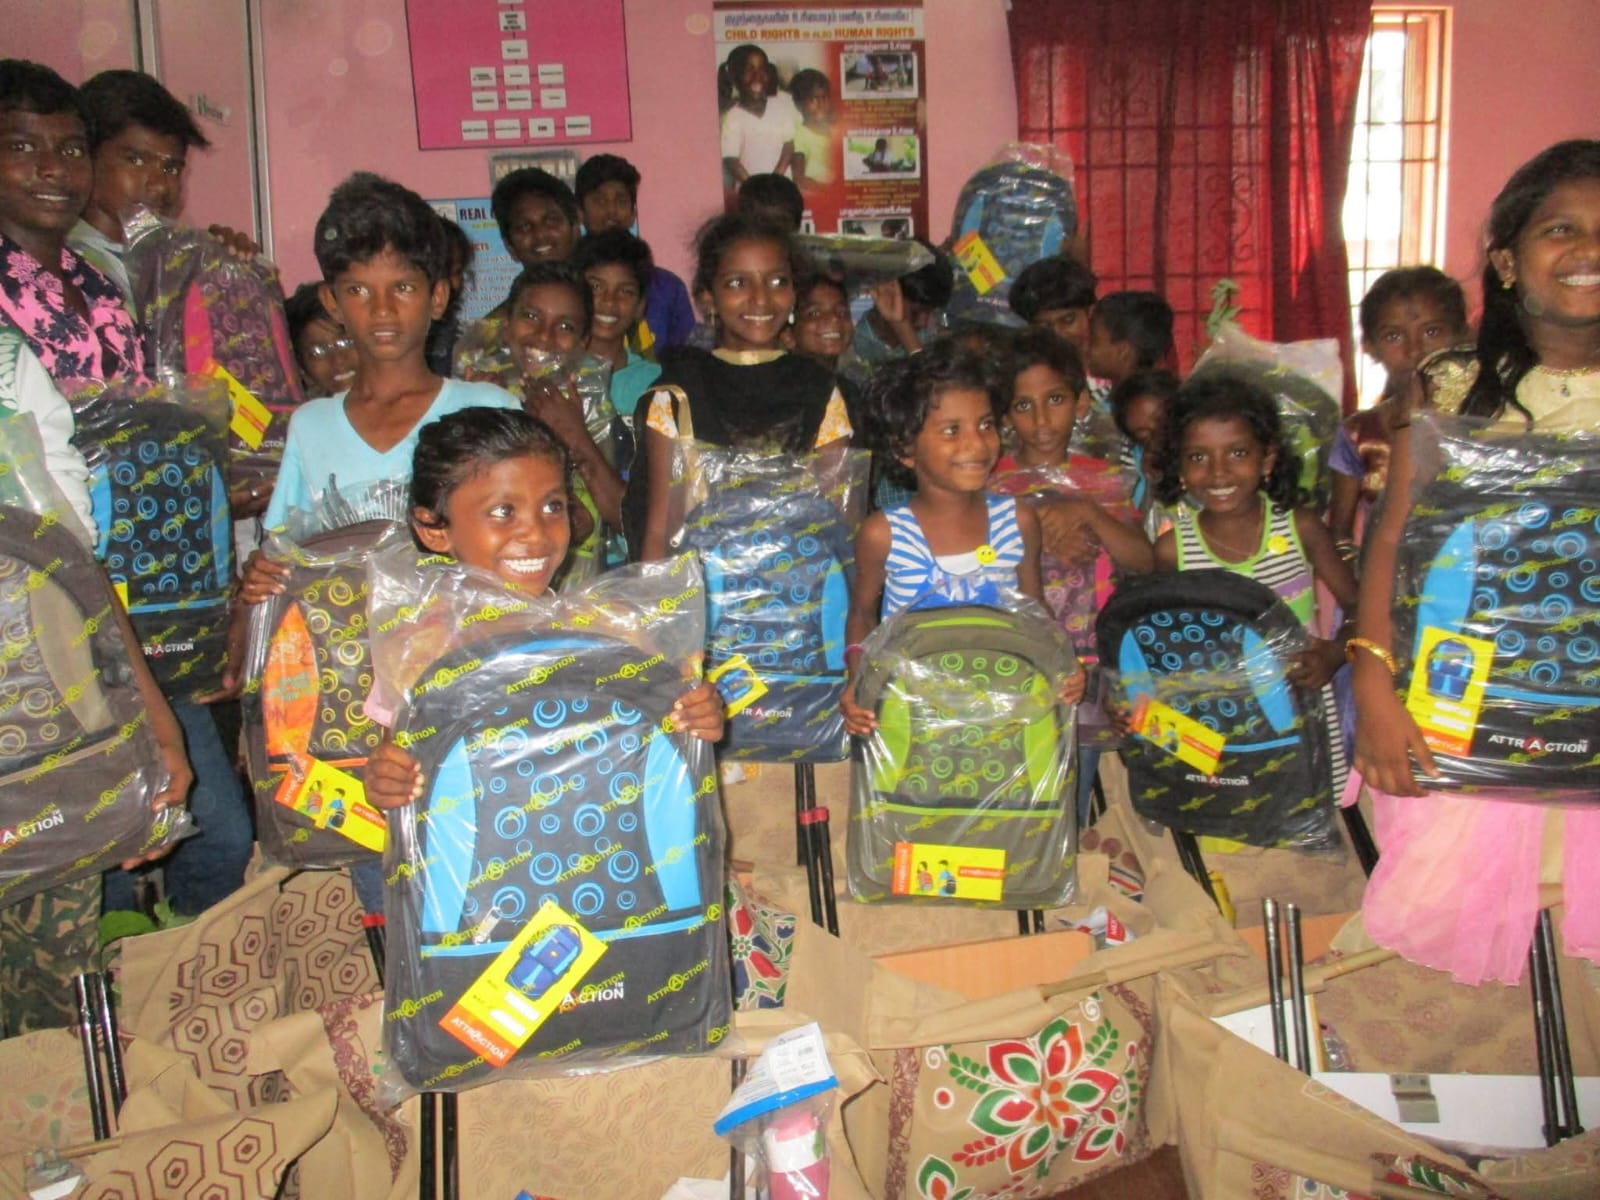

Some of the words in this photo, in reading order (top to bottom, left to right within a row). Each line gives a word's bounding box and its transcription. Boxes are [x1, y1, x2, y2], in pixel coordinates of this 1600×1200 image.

[725, 29, 757, 40] CHILD
[761, 28, 800, 39] RIGHTS
[834, 27, 873, 38] HUMAN
[876, 26, 915, 37] RIGHTS
[460, 207, 487, 221] REAL
[413, 658, 482, 698] ATTRACTION
[596, 652, 666, 686] ATTRACTION
[1488, 734, 1588, 753] ATTRACTION
[646, 959, 710, 1005] ATTRACTION
[451, 1015, 509, 1060] ATTRACTION
